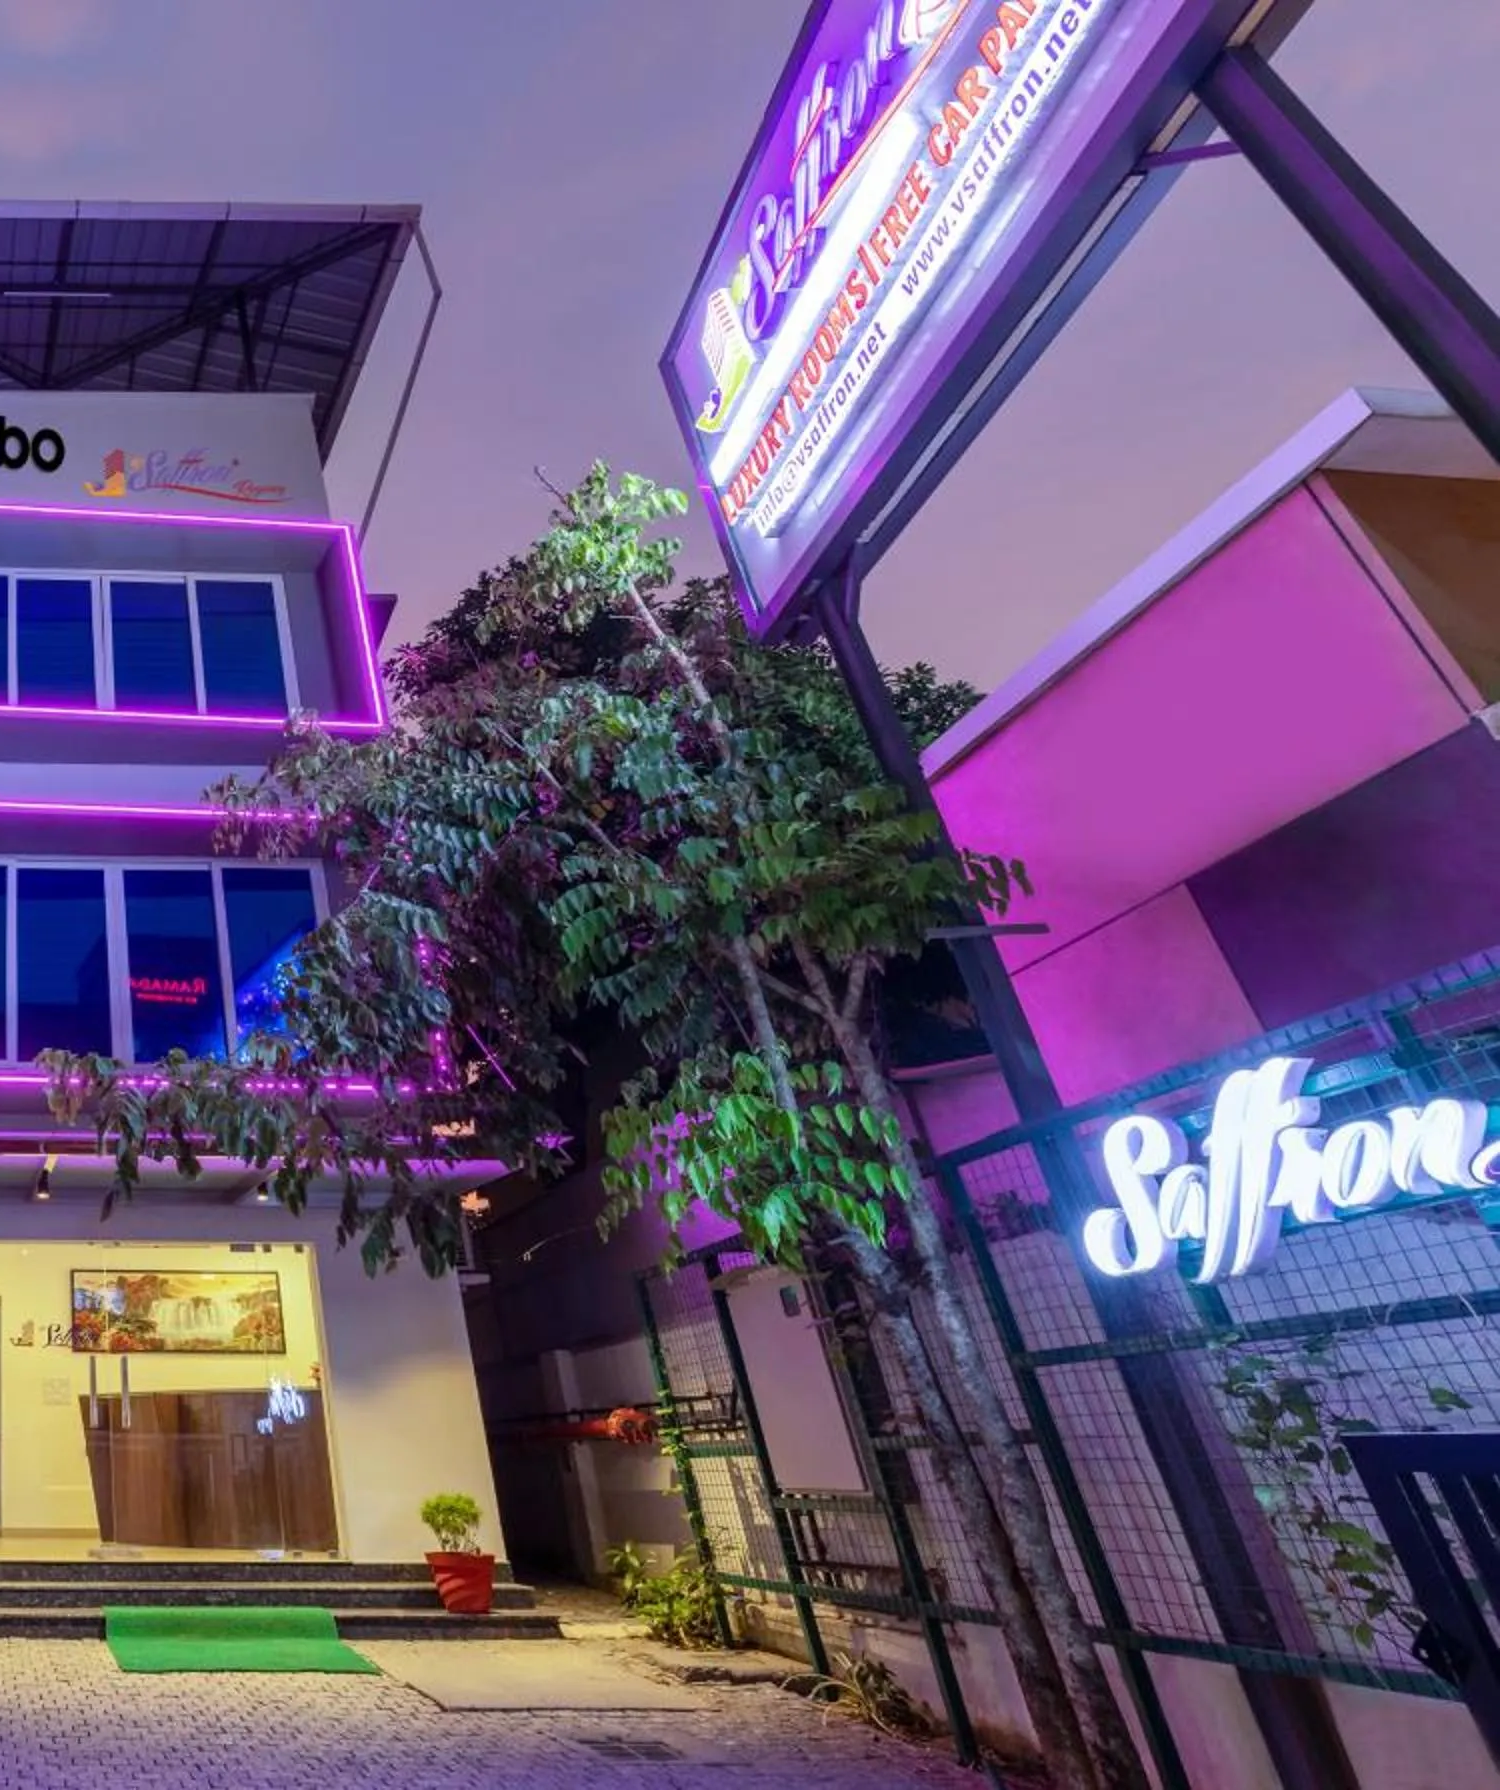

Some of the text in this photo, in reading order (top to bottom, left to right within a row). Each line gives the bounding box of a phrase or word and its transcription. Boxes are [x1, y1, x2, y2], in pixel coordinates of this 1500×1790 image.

[719, 396, 794, 526] LUXURY
[928, 66, 990, 166] CAR
[757, 321, 888, 529] info@vsaffron.net
[1084, 1057, 1488, 1284] Saffron
